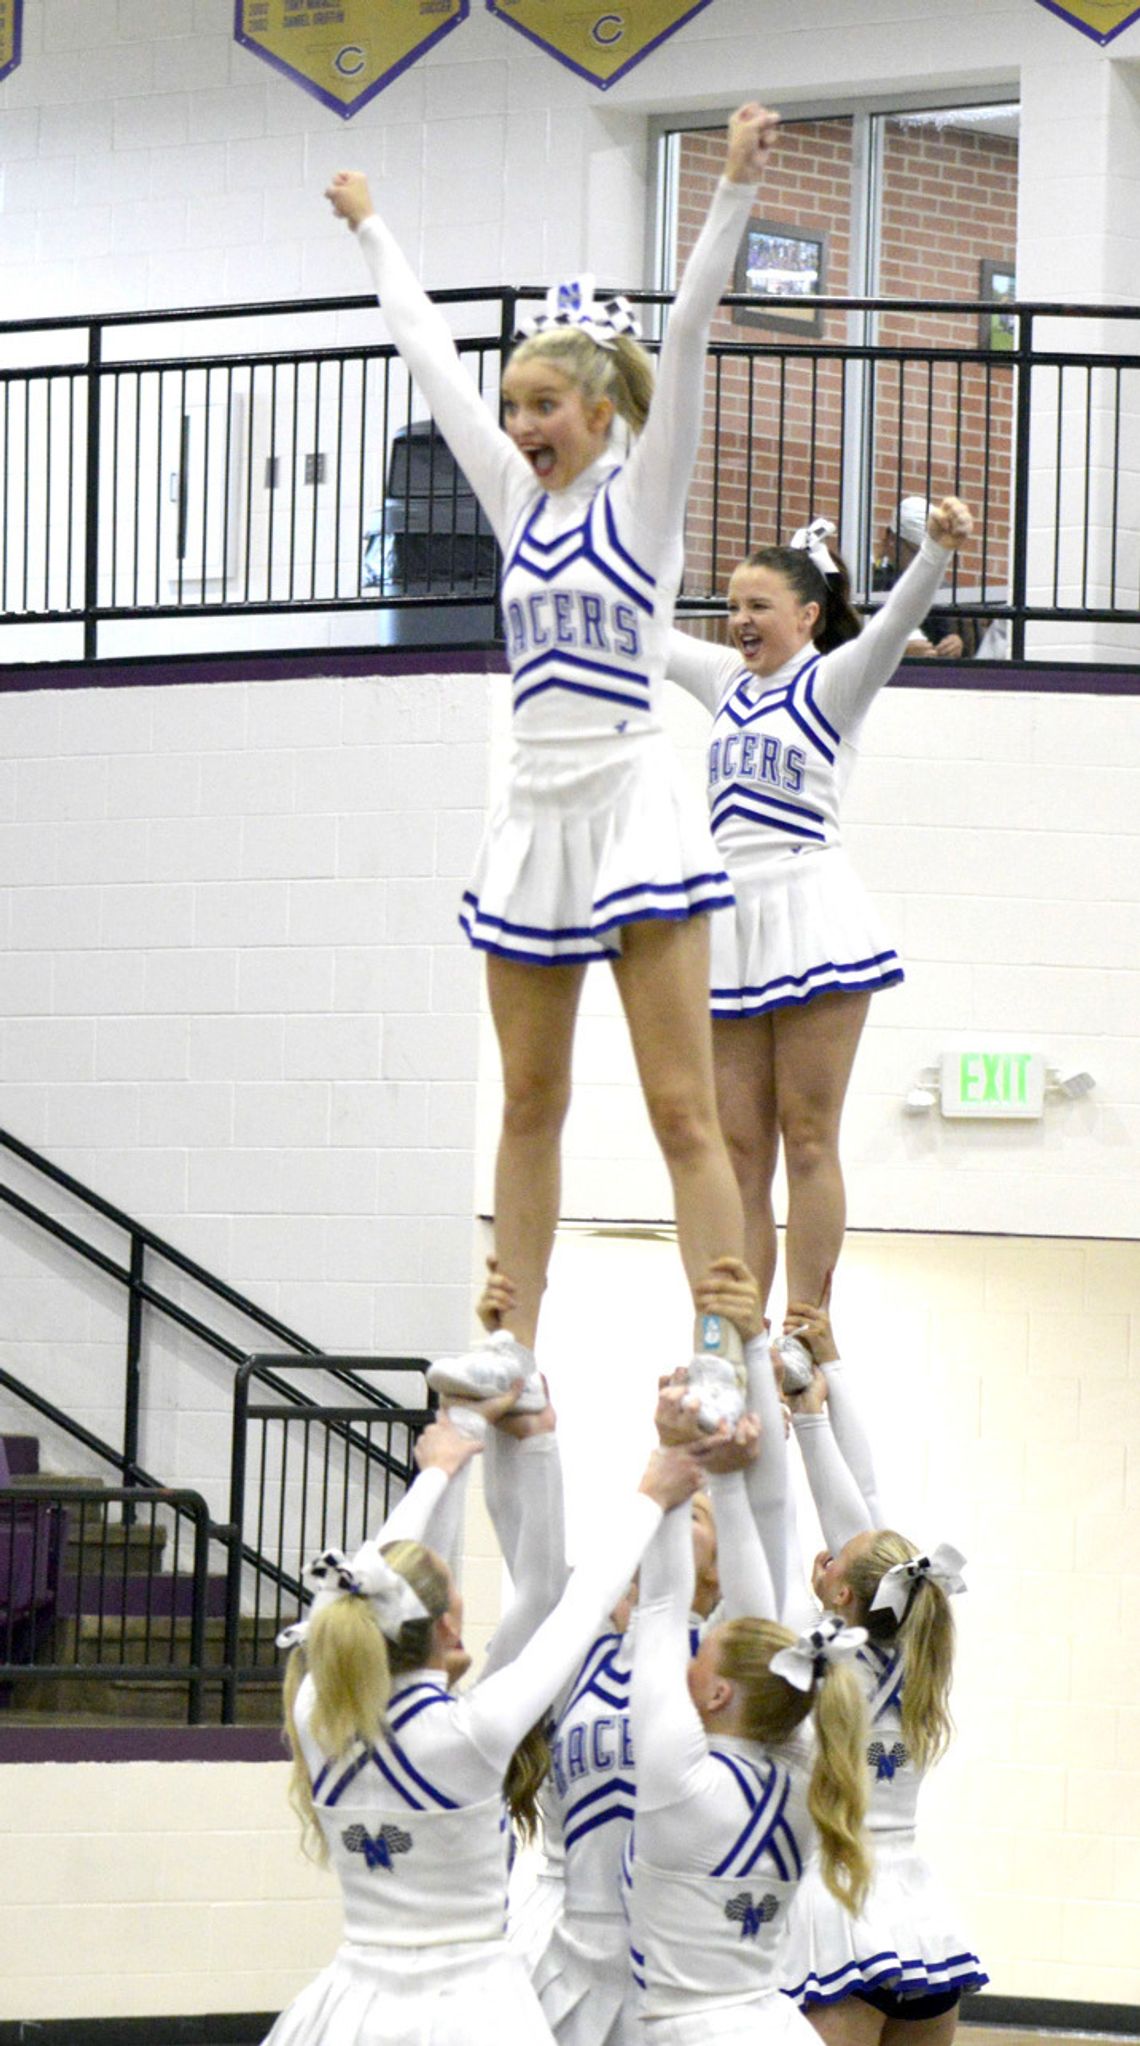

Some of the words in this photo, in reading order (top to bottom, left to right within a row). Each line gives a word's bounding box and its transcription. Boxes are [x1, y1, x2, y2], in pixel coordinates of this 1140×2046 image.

[592, 14, 624, 45] C
[334, 45, 366, 76] C
[558, 281, 581, 310] N
[508, 588, 643, 660] ACERS
[960, 1052, 1032, 1104] EXIT
